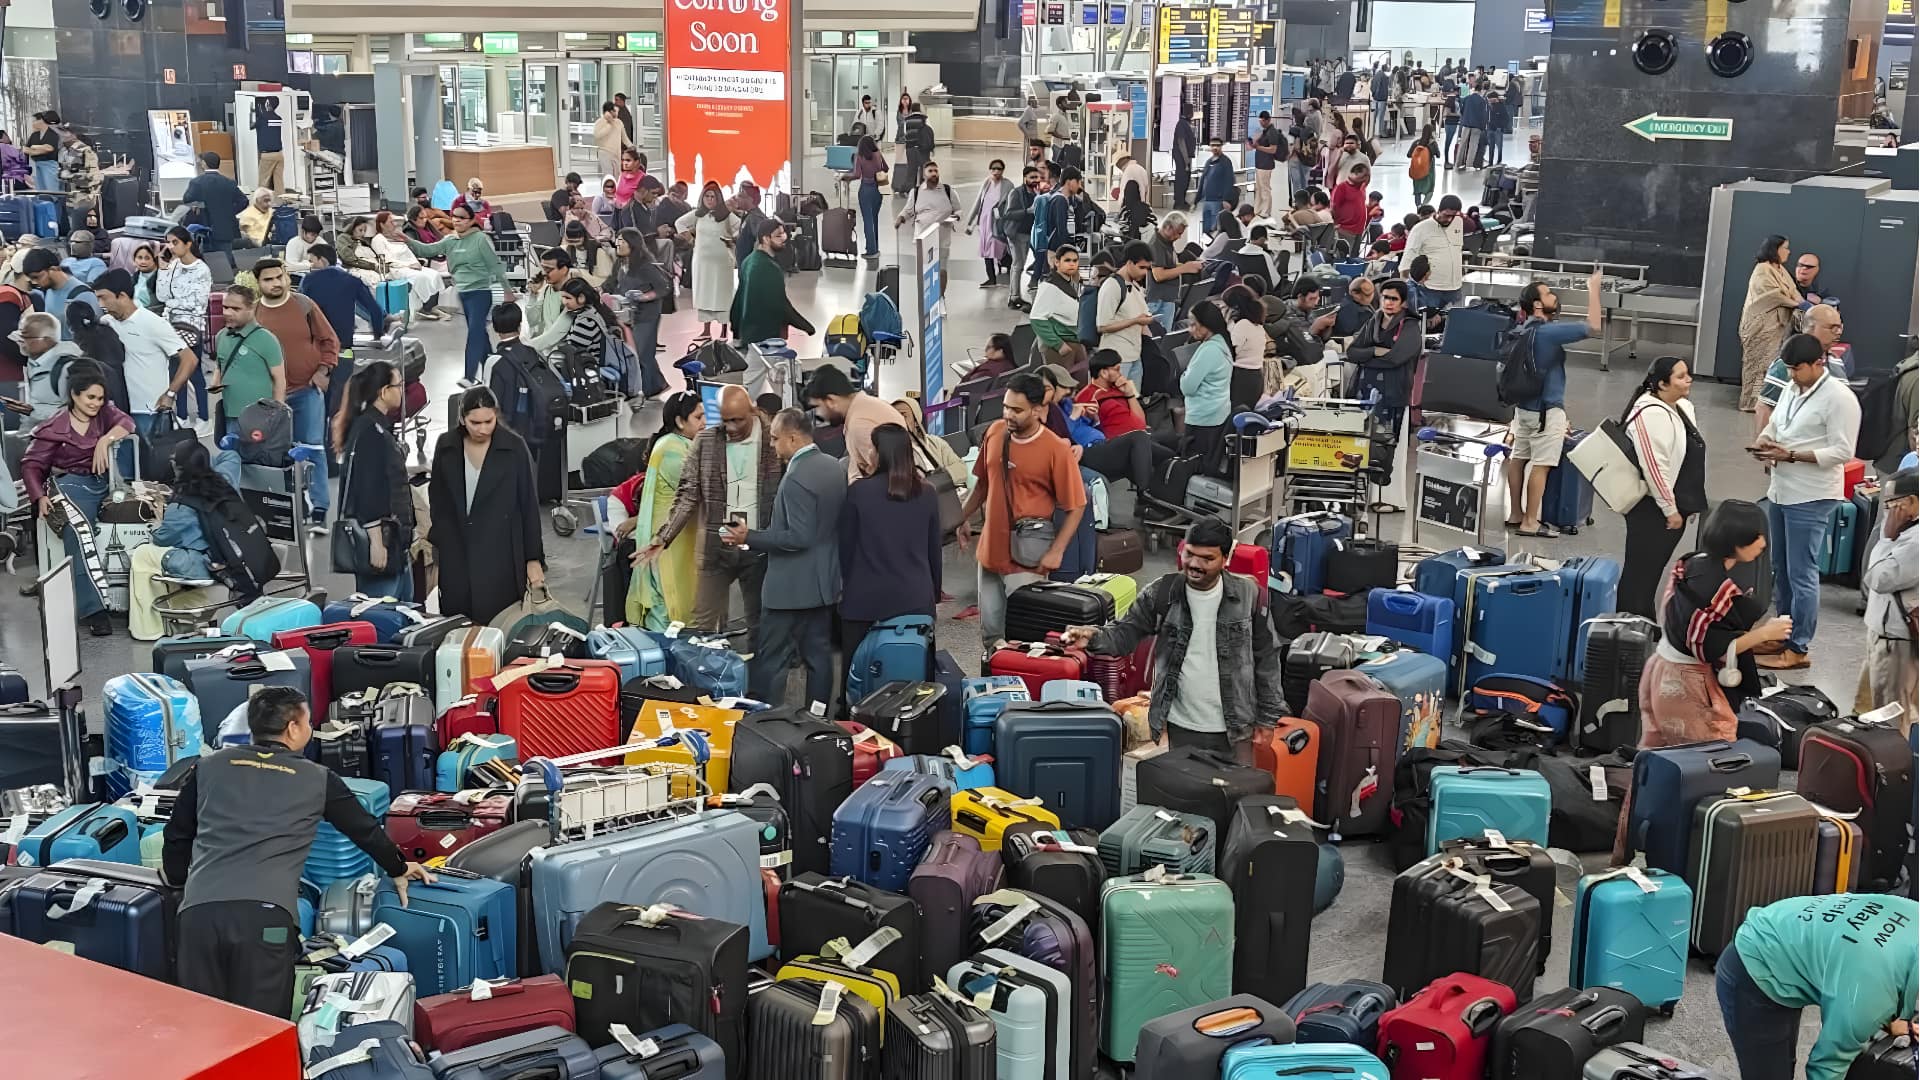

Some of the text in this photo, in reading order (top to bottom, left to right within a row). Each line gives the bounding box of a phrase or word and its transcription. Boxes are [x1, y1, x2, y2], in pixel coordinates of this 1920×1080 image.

[690, 21, 760, 53] Soon
[1649, 122, 1704, 133] EMERGENCY
[1821, 896, 1857, 923] help
[1841, 901, 1884, 944] May I
[1873, 911, 1911, 947] How
